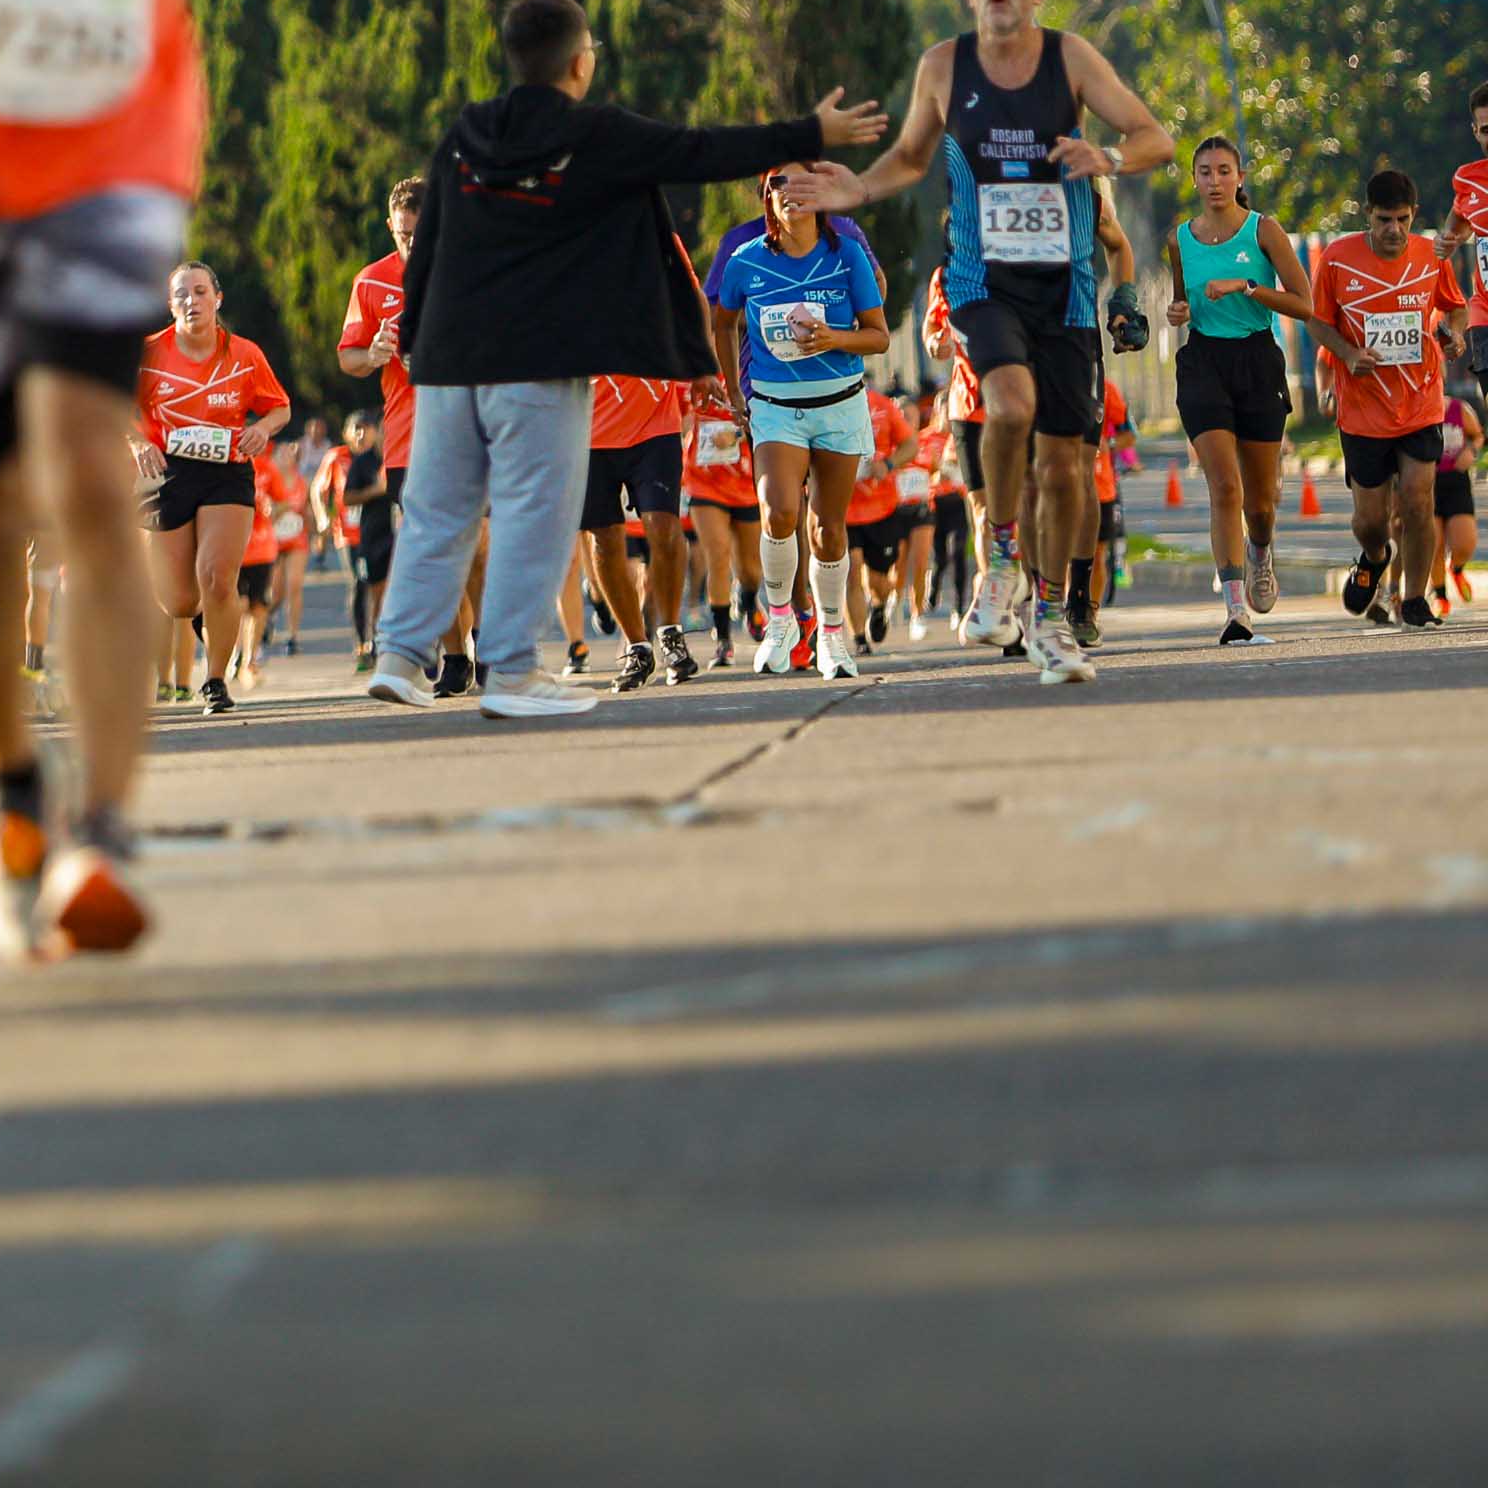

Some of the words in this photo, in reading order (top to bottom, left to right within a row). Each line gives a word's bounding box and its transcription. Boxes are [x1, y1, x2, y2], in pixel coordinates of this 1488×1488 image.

[991, 128, 1035, 144] ROSARIO
[980, 143, 1048, 159] CALLEYPISTA
[991, 191, 1012, 202] 15K
[986, 207, 1065, 232] 1283
[803, 290, 826, 301] 15K
[1397, 294, 1417, 305] 15K
[768, 311, 784, 320] 15K
[1367, 328, 1419, 348] 7408
[207, 393, 226, 405] 15K
[170, 439, 226, 460] 7485
